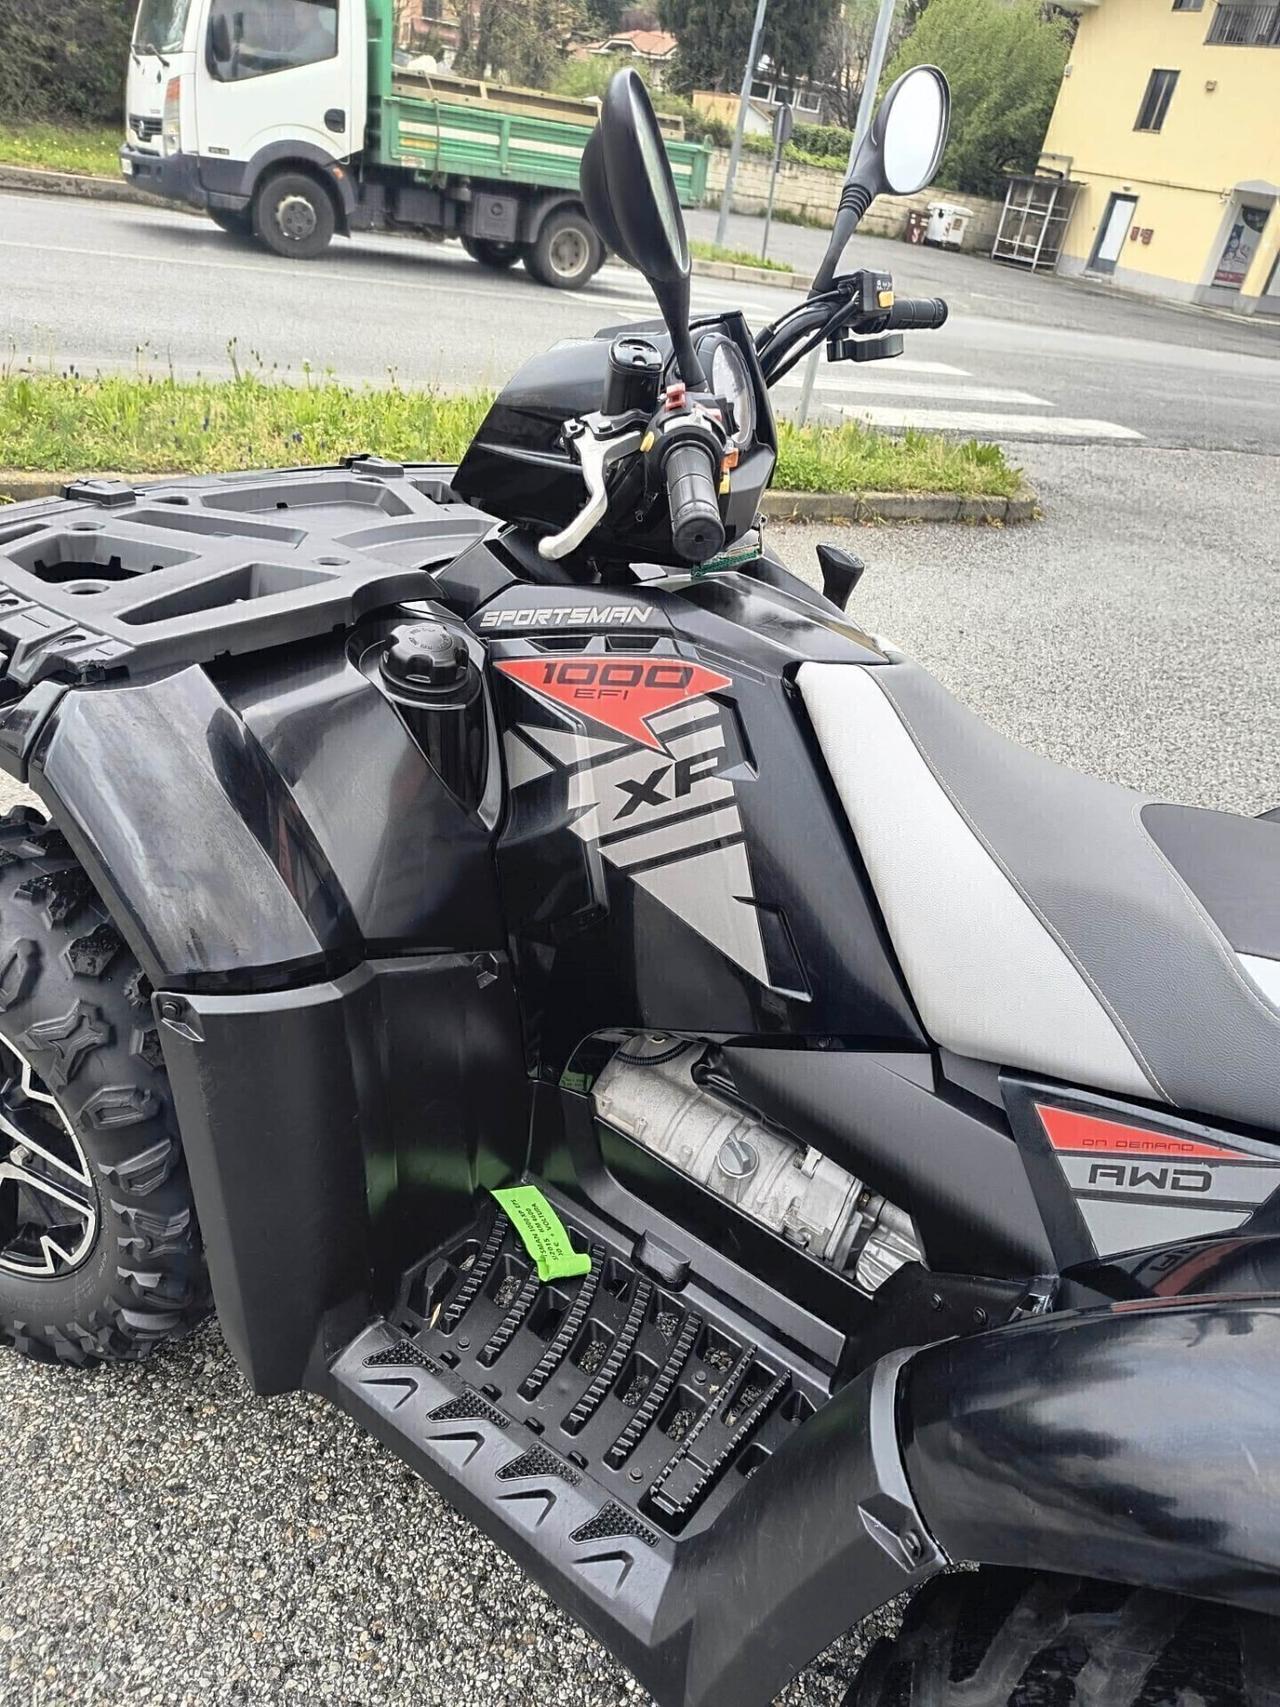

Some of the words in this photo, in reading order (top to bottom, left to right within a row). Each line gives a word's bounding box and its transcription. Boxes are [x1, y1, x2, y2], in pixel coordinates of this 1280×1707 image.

[480, 606, 653, 628] SPORTSMAN
[543, 662, 694, 689] 1000
[574, 688, 629, 701] EFI
[1115, 1139, 1195, 1152] DEMAND
[1088, 1163, 1212, 1193] AWD
